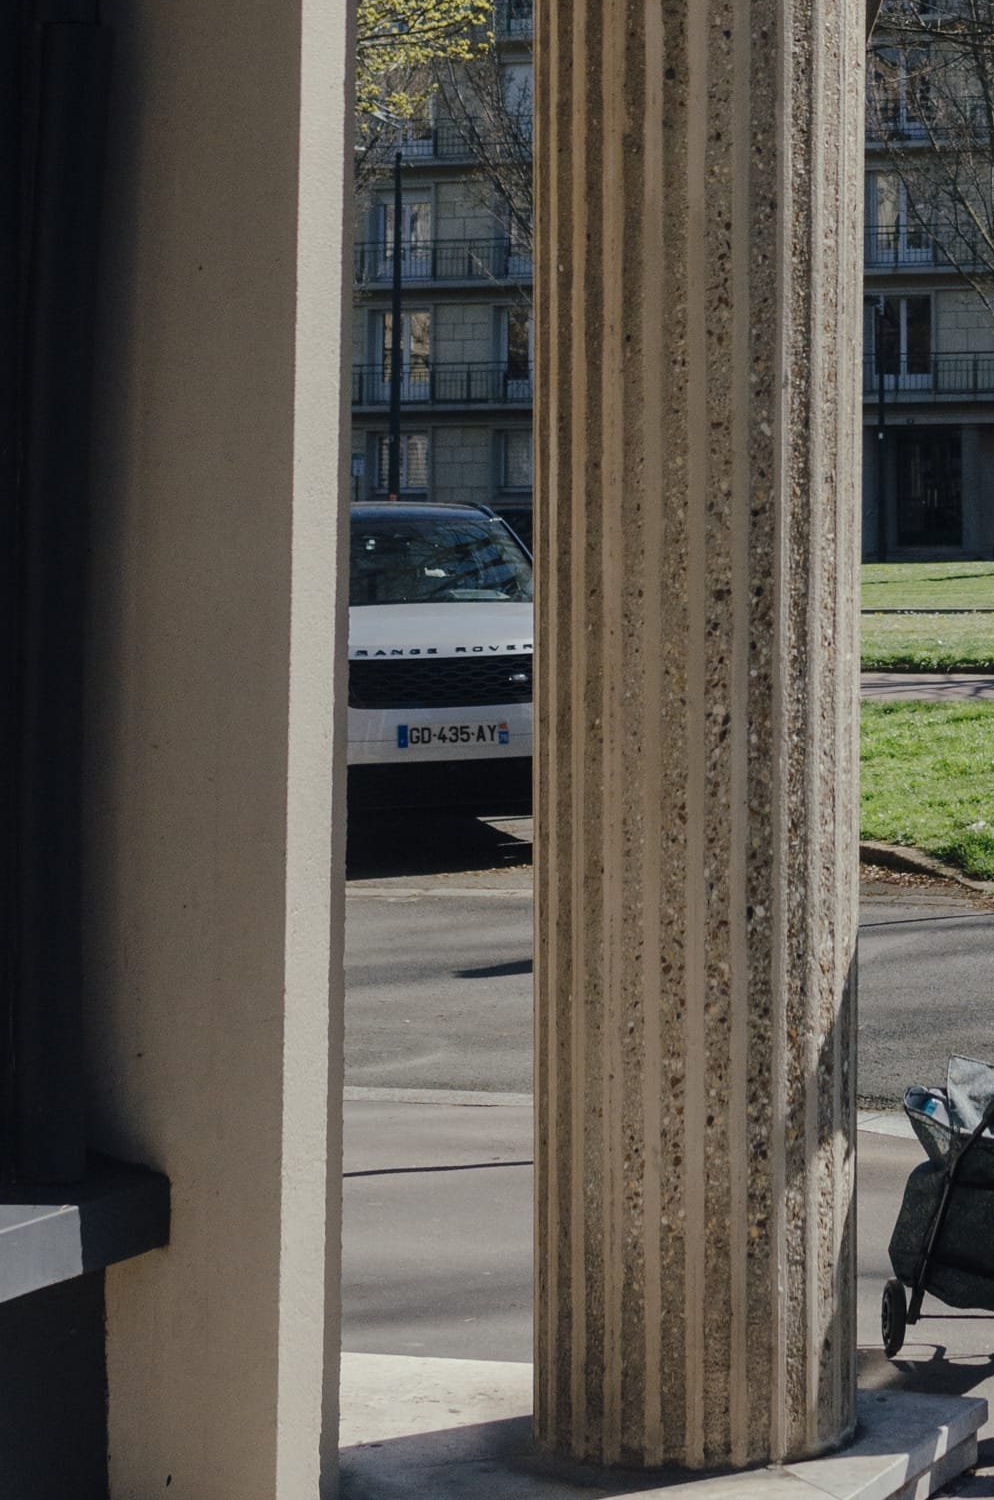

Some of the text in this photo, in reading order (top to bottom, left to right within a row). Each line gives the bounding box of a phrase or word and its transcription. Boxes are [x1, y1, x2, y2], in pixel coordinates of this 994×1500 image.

[354, 643, 533, 657] RANGE ROVER
[409, 724, 497, 745] GD-435-AY
